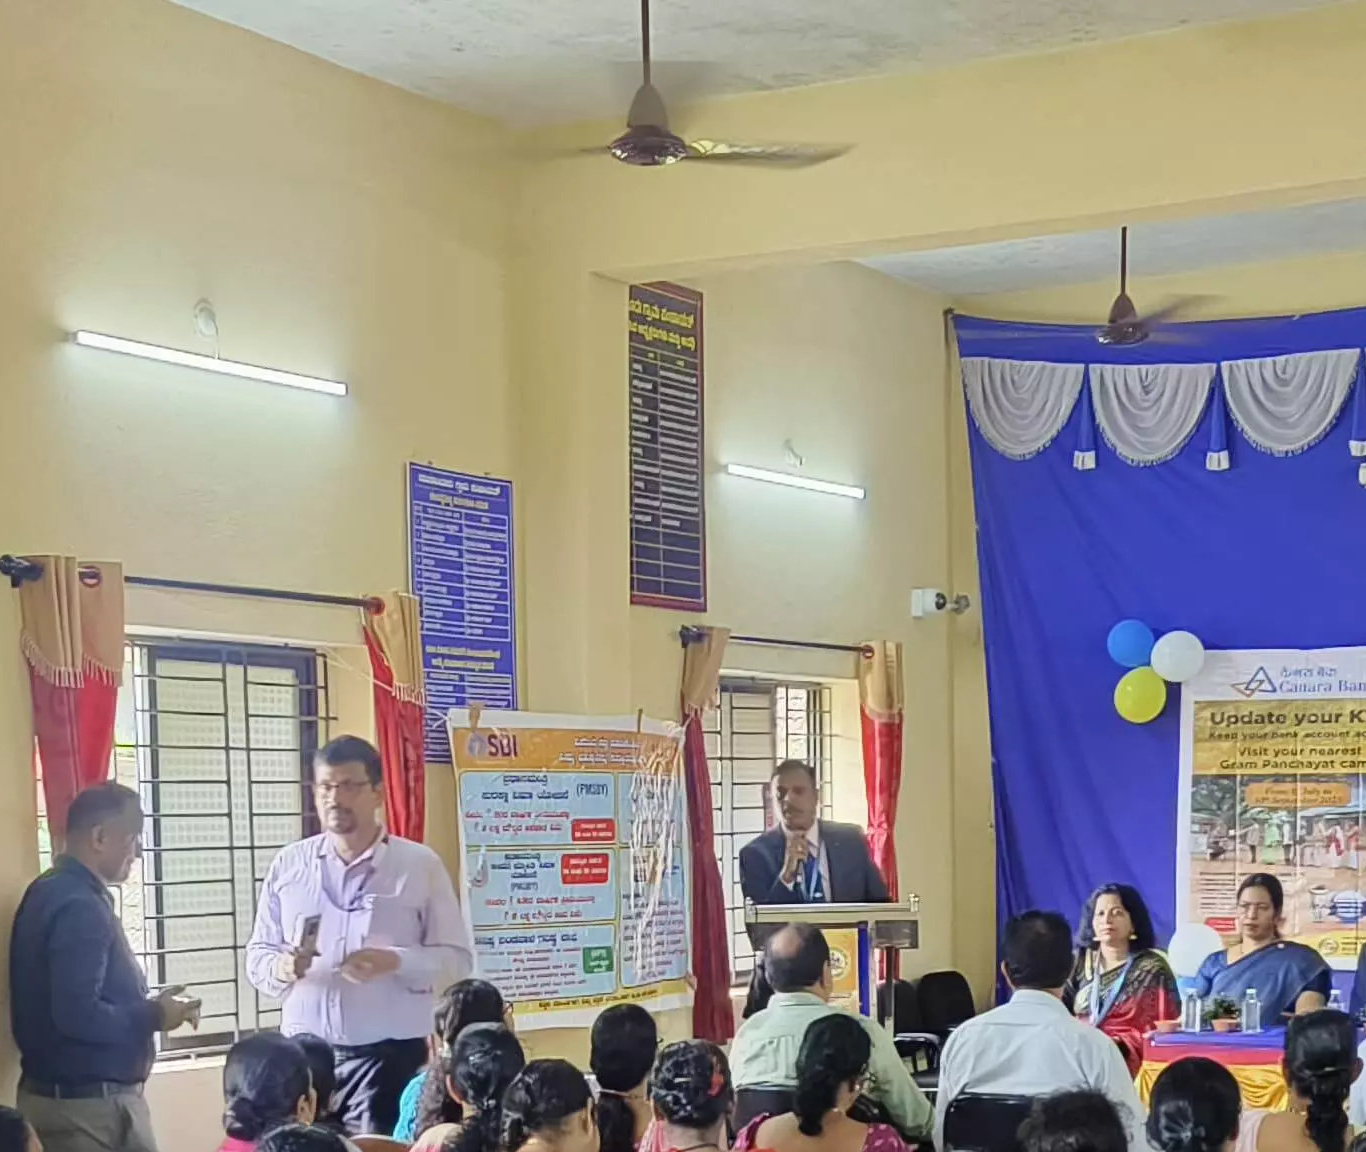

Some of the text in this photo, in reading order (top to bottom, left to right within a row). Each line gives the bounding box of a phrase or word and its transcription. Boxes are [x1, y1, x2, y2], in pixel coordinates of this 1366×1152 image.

[1279, 679, 1332, 694] Canara
[1210, 711, 1286, 727] Update
[1294, 712, 1343, 726] your
[1209, 731, 1238, 740] Keep
[1241, 732, 1270, 741] your
[1272, 730, 1298, 739] bank
[1303, 730, 1350, 739] account
[487, 733, 517, 758] SBI
[1238, 746, 1362, 758] Visit your nearest
[1220, 759, 1257, 770] Gram
[1262, 759, 1336, 770] Panchayat
